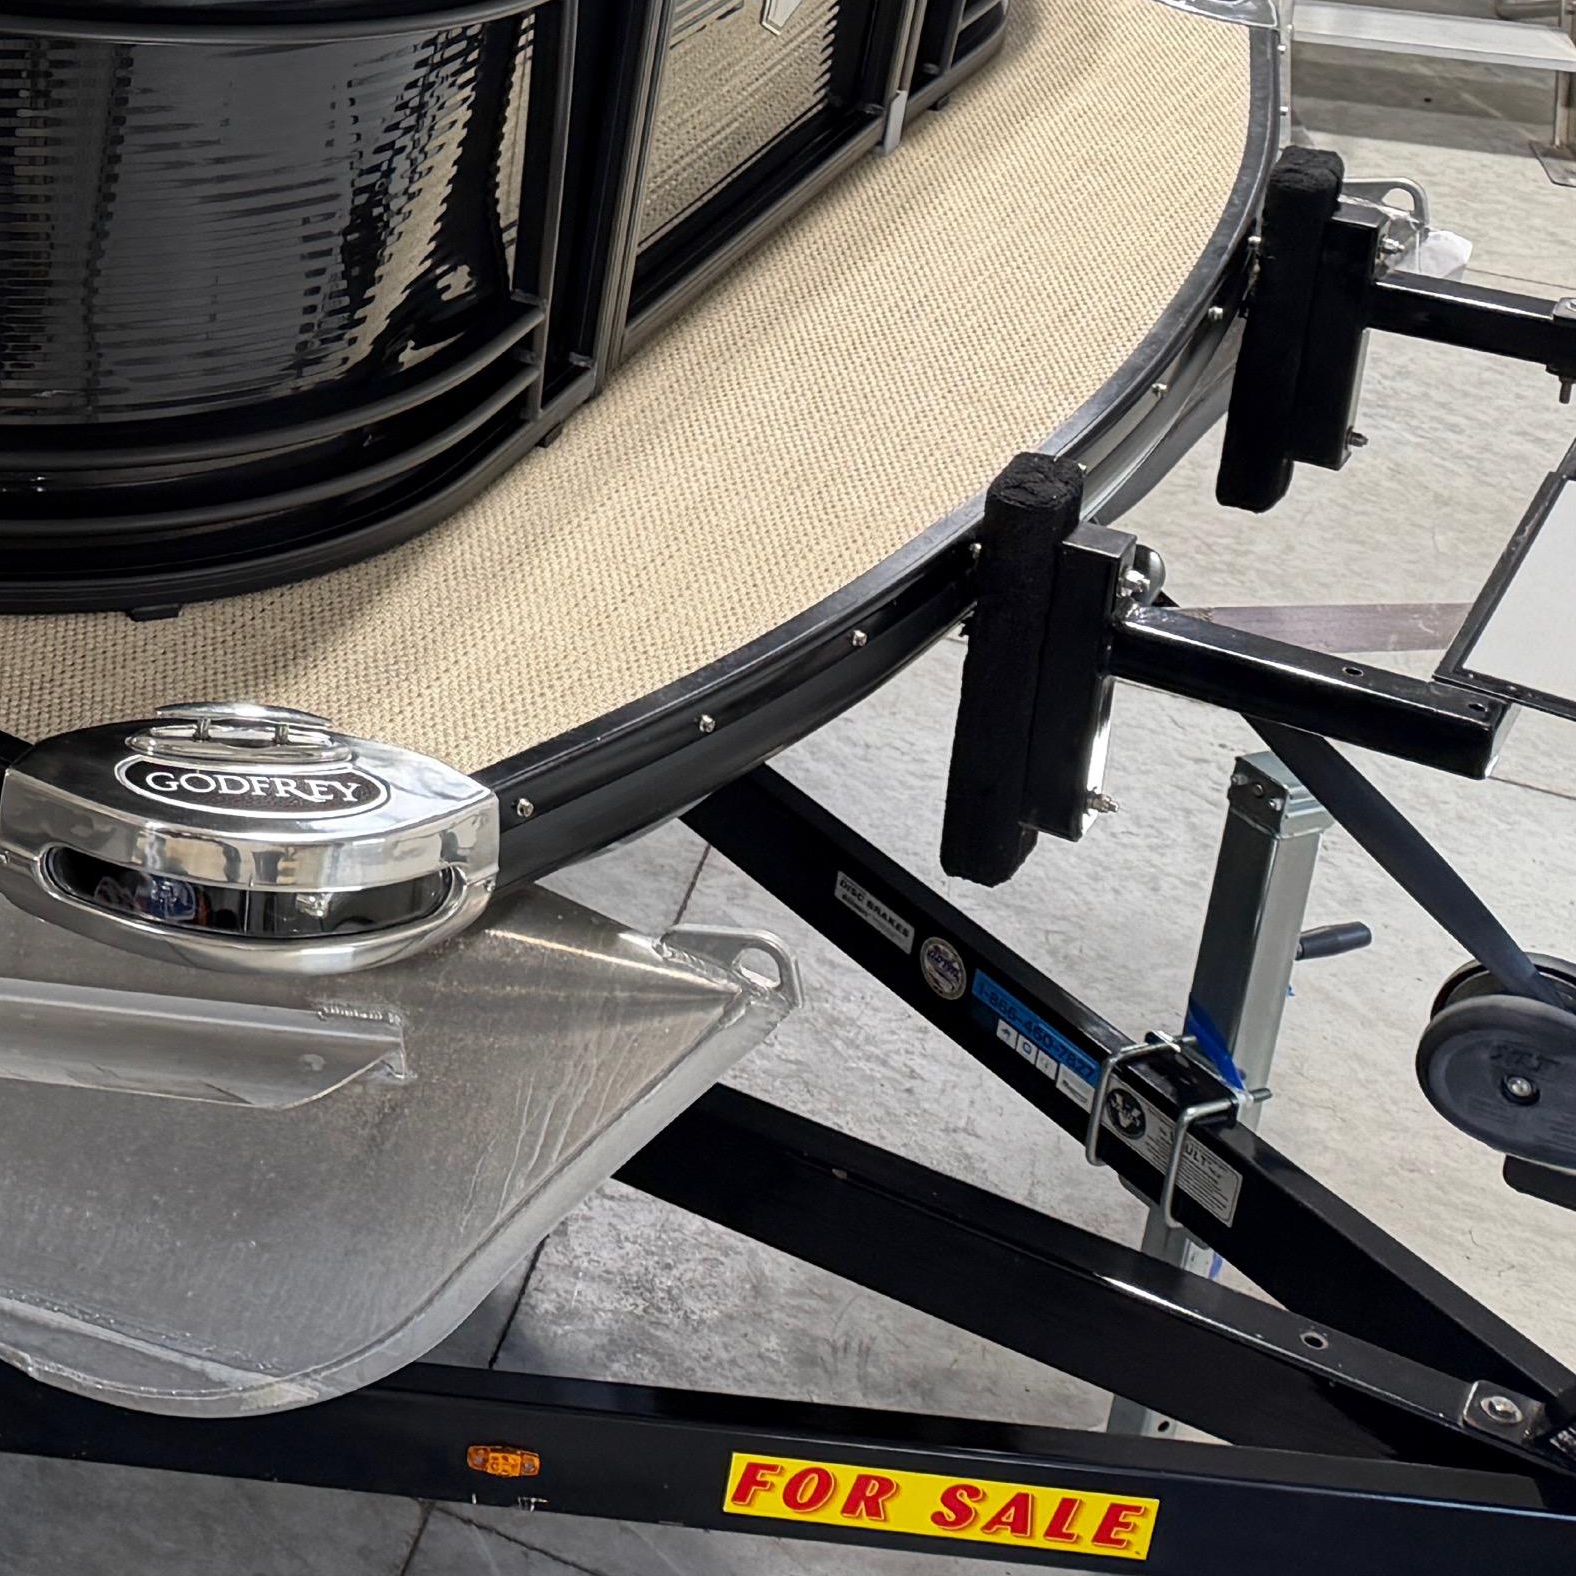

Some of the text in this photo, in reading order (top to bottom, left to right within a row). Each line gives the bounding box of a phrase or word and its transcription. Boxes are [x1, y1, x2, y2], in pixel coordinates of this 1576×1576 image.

[146, 771, 361, 803] GODFREY
[840, 879, 865, 901] DISC
[867, 899, 909, 938] BRAKES
[731, 1461, 1146, 1549] FOR SALE
